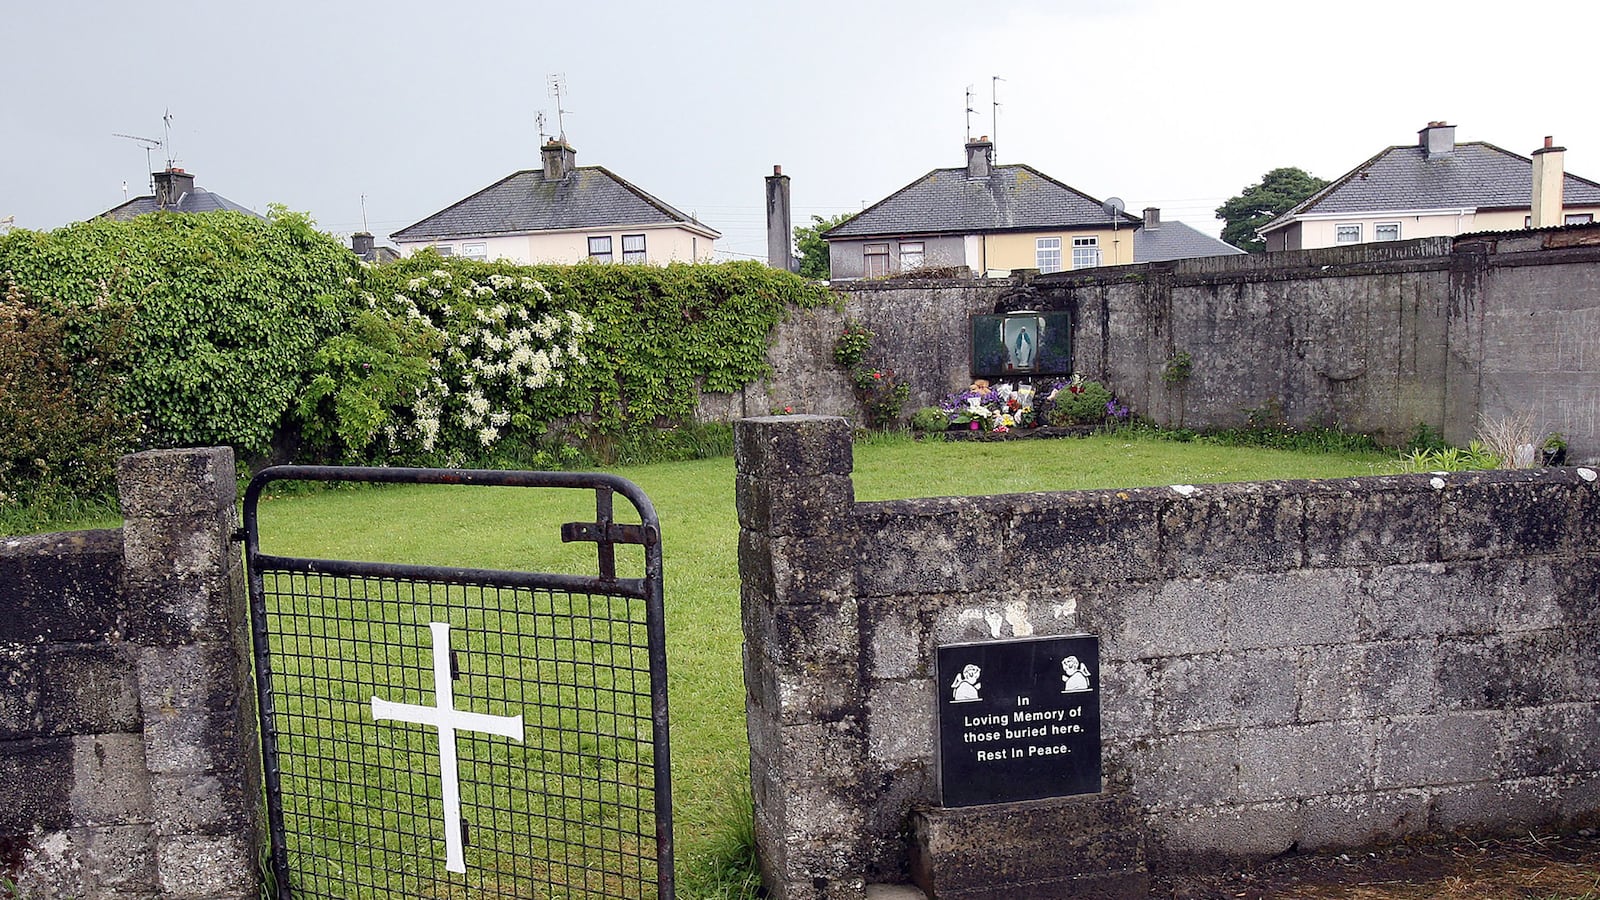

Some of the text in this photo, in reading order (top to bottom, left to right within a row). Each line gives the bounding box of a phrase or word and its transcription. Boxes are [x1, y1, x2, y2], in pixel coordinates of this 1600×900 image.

[1017, 695, 1030, 706] In
[964, 706, 1082, 727] Loving Memory of
[963, 724, 1085, 743] those buried here.
[977, 744, 1072, 762] Rest In Peace.
